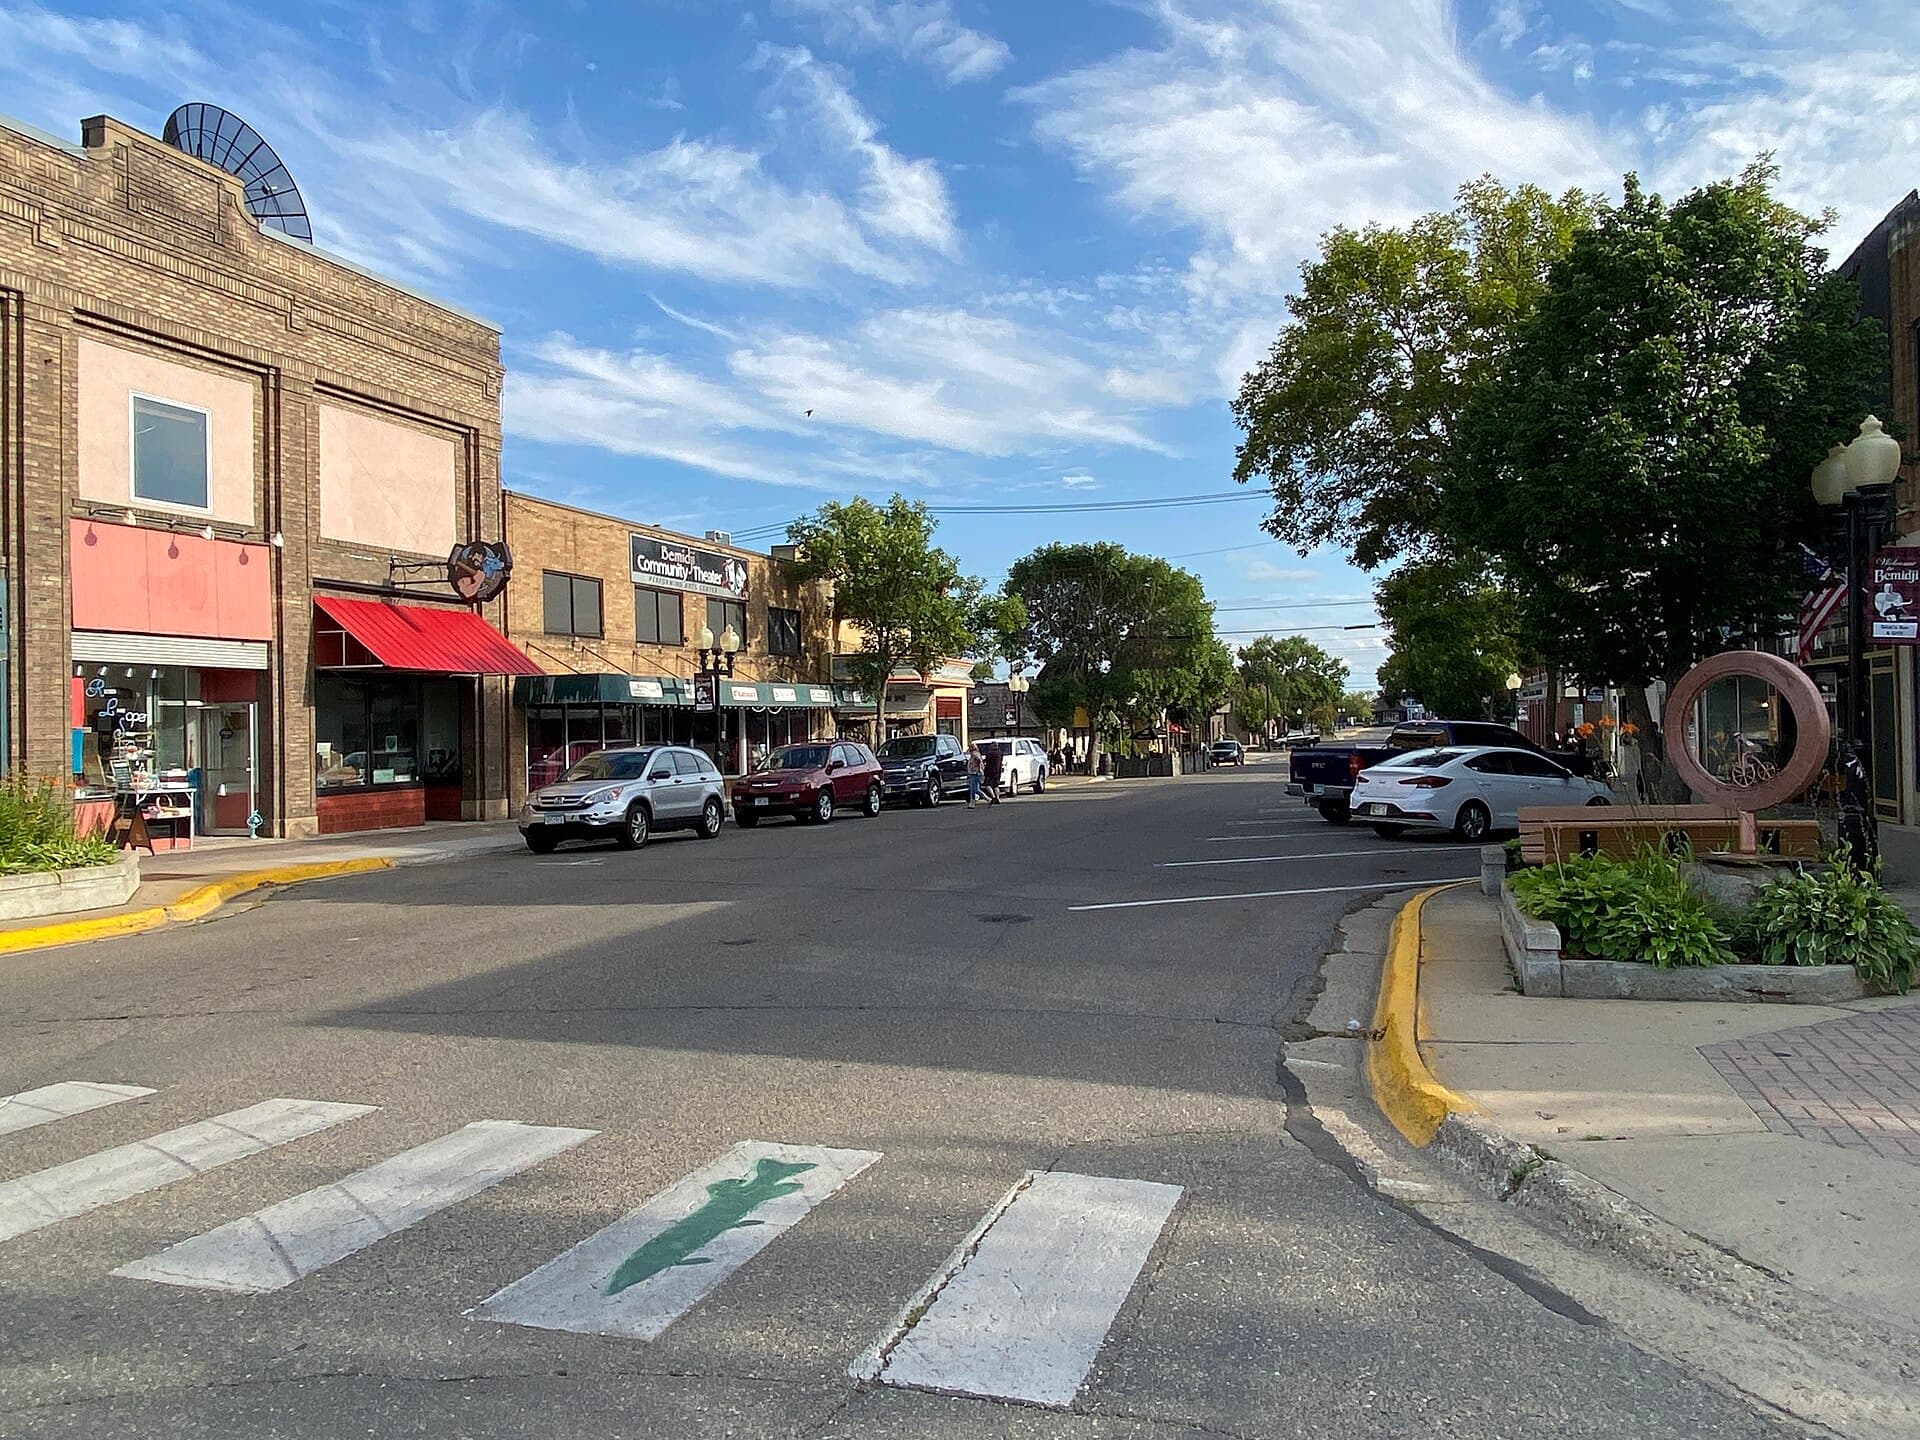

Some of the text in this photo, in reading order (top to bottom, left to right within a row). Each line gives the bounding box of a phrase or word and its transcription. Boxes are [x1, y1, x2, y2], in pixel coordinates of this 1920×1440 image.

[637, 555, 723, 584] Community Theater
[661, 546, 695, 574] Bemidji
[648, 576, 718, 593] PERFORMING ARTS CENTER
[1874, 569, 1919, 583] Bemidji
